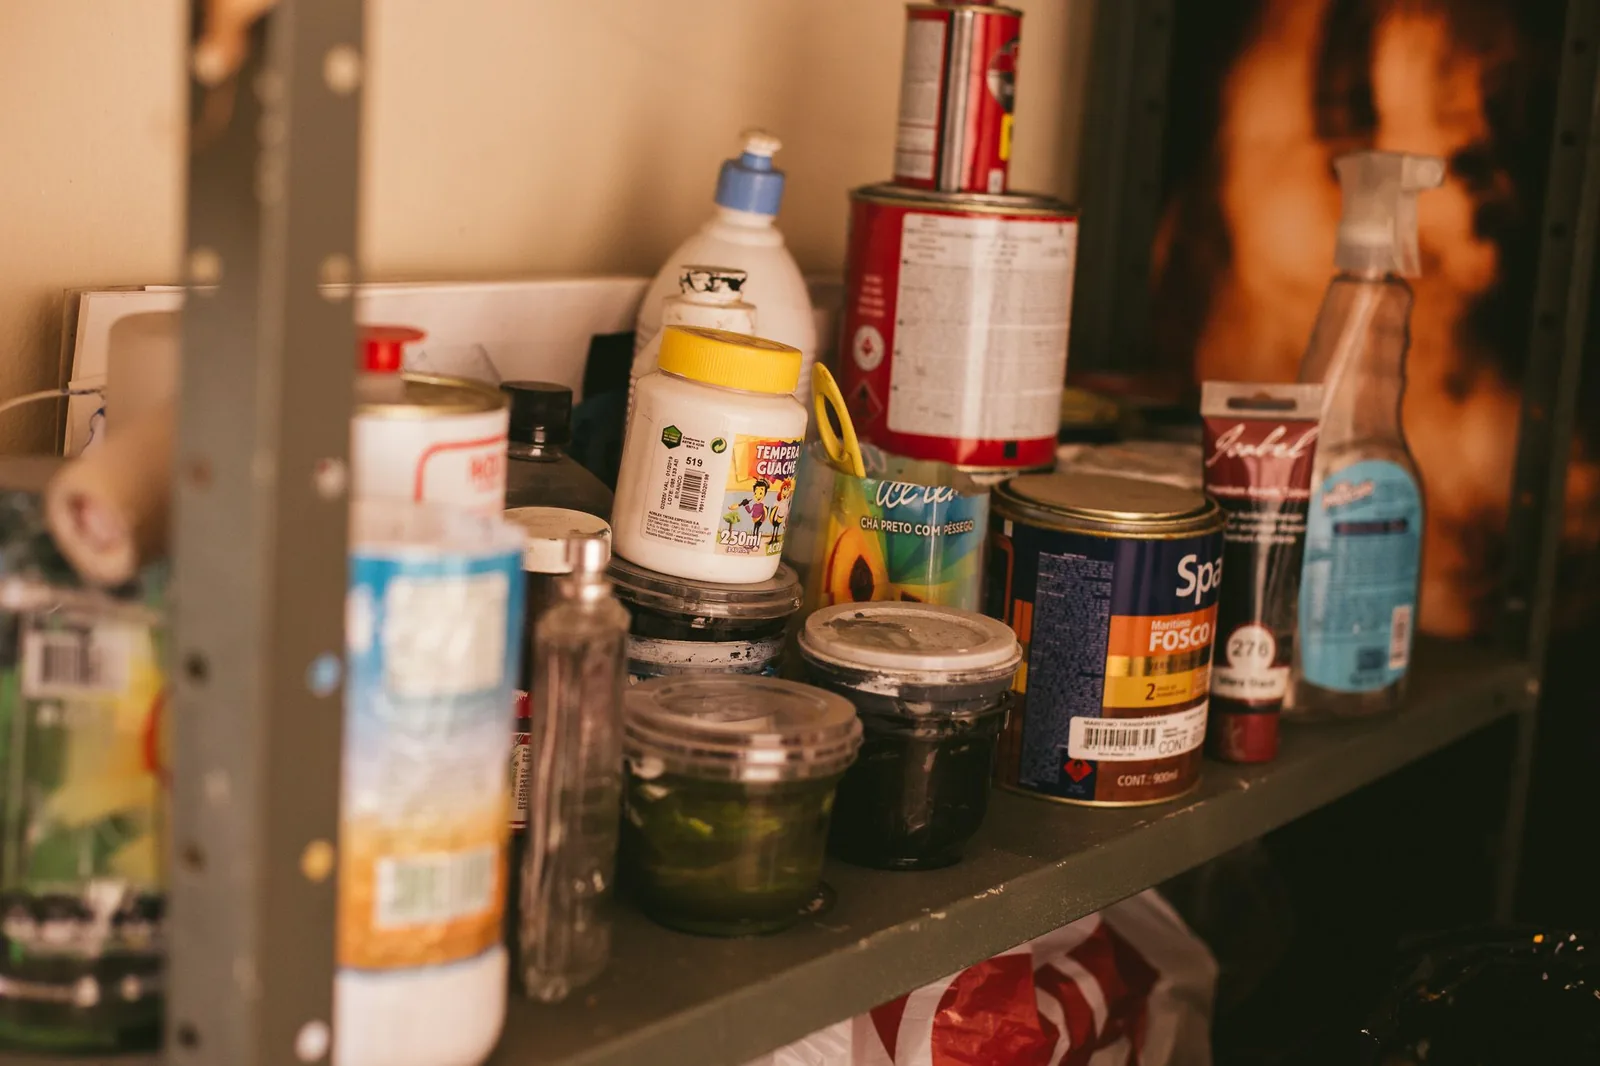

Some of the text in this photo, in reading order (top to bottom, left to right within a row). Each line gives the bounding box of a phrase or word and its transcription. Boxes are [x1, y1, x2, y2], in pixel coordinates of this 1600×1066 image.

[686, 456, 703, 467] 519
[756, 445, 800, 460] TEMPERA
[756, 460, 797, 475] GUACHE
[674, 475, 683, 499] BRANCO
[860, 516, 879, 531] CHÁ
[881, 519, 912, 534] PRETO
[914, 524, 941, 536] COM
[720, 529, 761, 547] 250ml
[1175, 554, 1222, 605] Spa
[1149, 621, 1210, 652] FOSCO
[1231, 639, 1269, 657] 276
[1145, 683, 1156, 701] 2
[1152, 769, 1179, 784] 900ml
